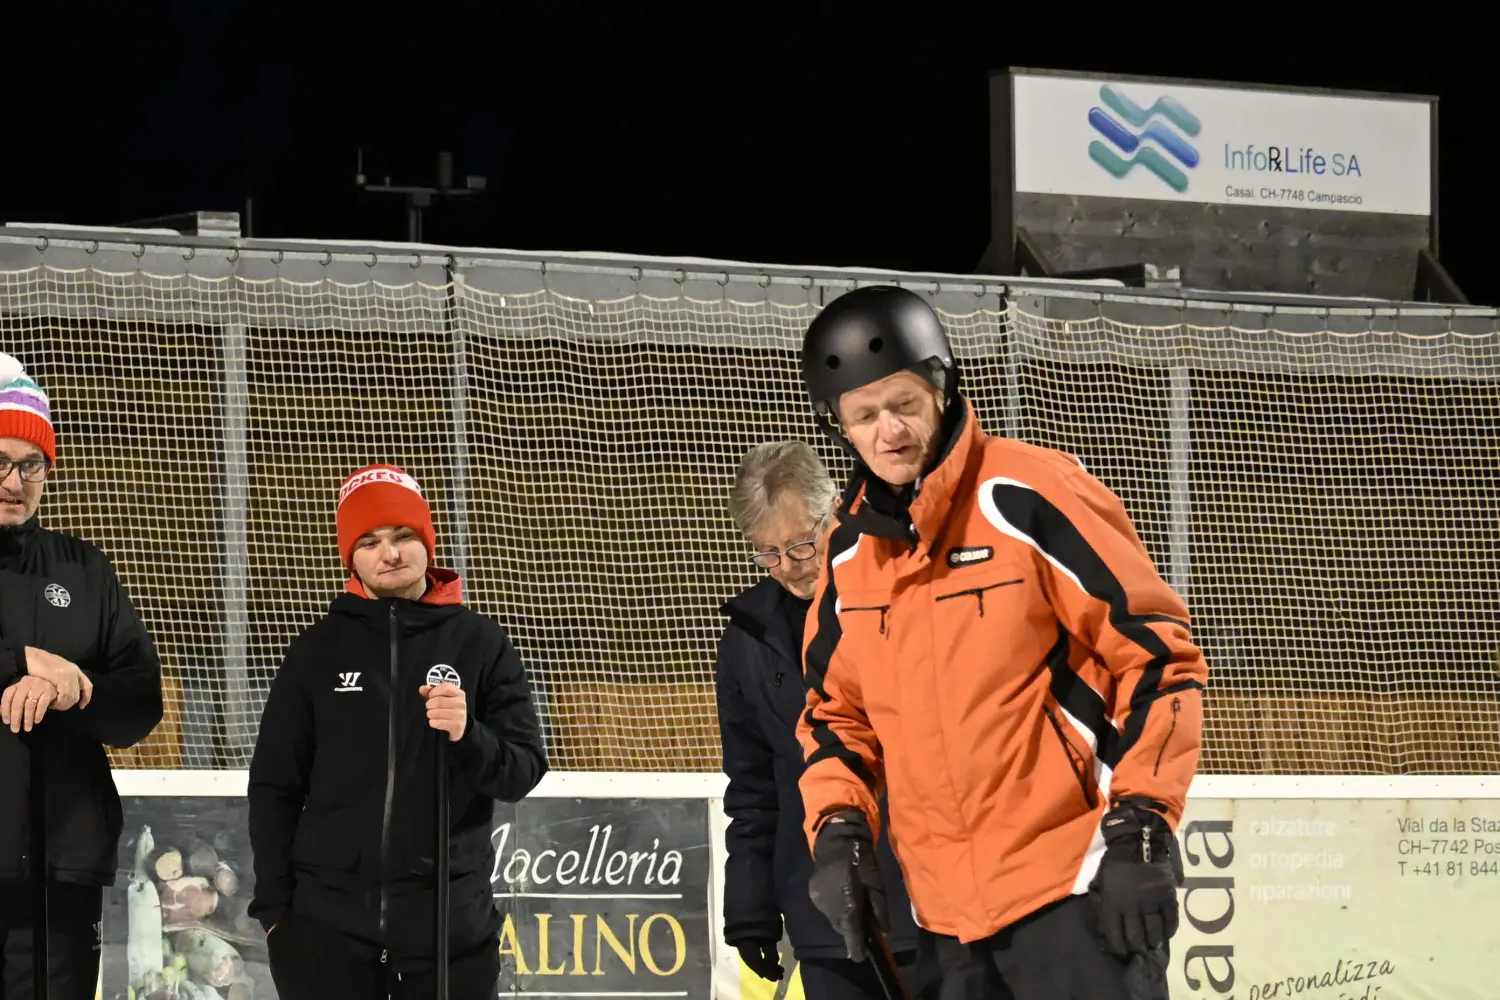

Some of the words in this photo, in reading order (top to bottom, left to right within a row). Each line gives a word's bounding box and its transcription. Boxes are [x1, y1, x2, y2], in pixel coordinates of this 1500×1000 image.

[1332, 153, 1362, 177] SA
[1260, 188, 1304, 201] CH-7748
[1307, 190, 1363, 205] Campascio
[1397, 817, 1424, 833] Vial
[1429, 817, 1448, 833] da
[1453, 817, 1466, 833] la
[1397, 861, 1408, 877] T
[1413, 861, 1440, 876] +41
[1446, 861, 1463, 876] 81
[1470, 861, 1499, 876] 844
